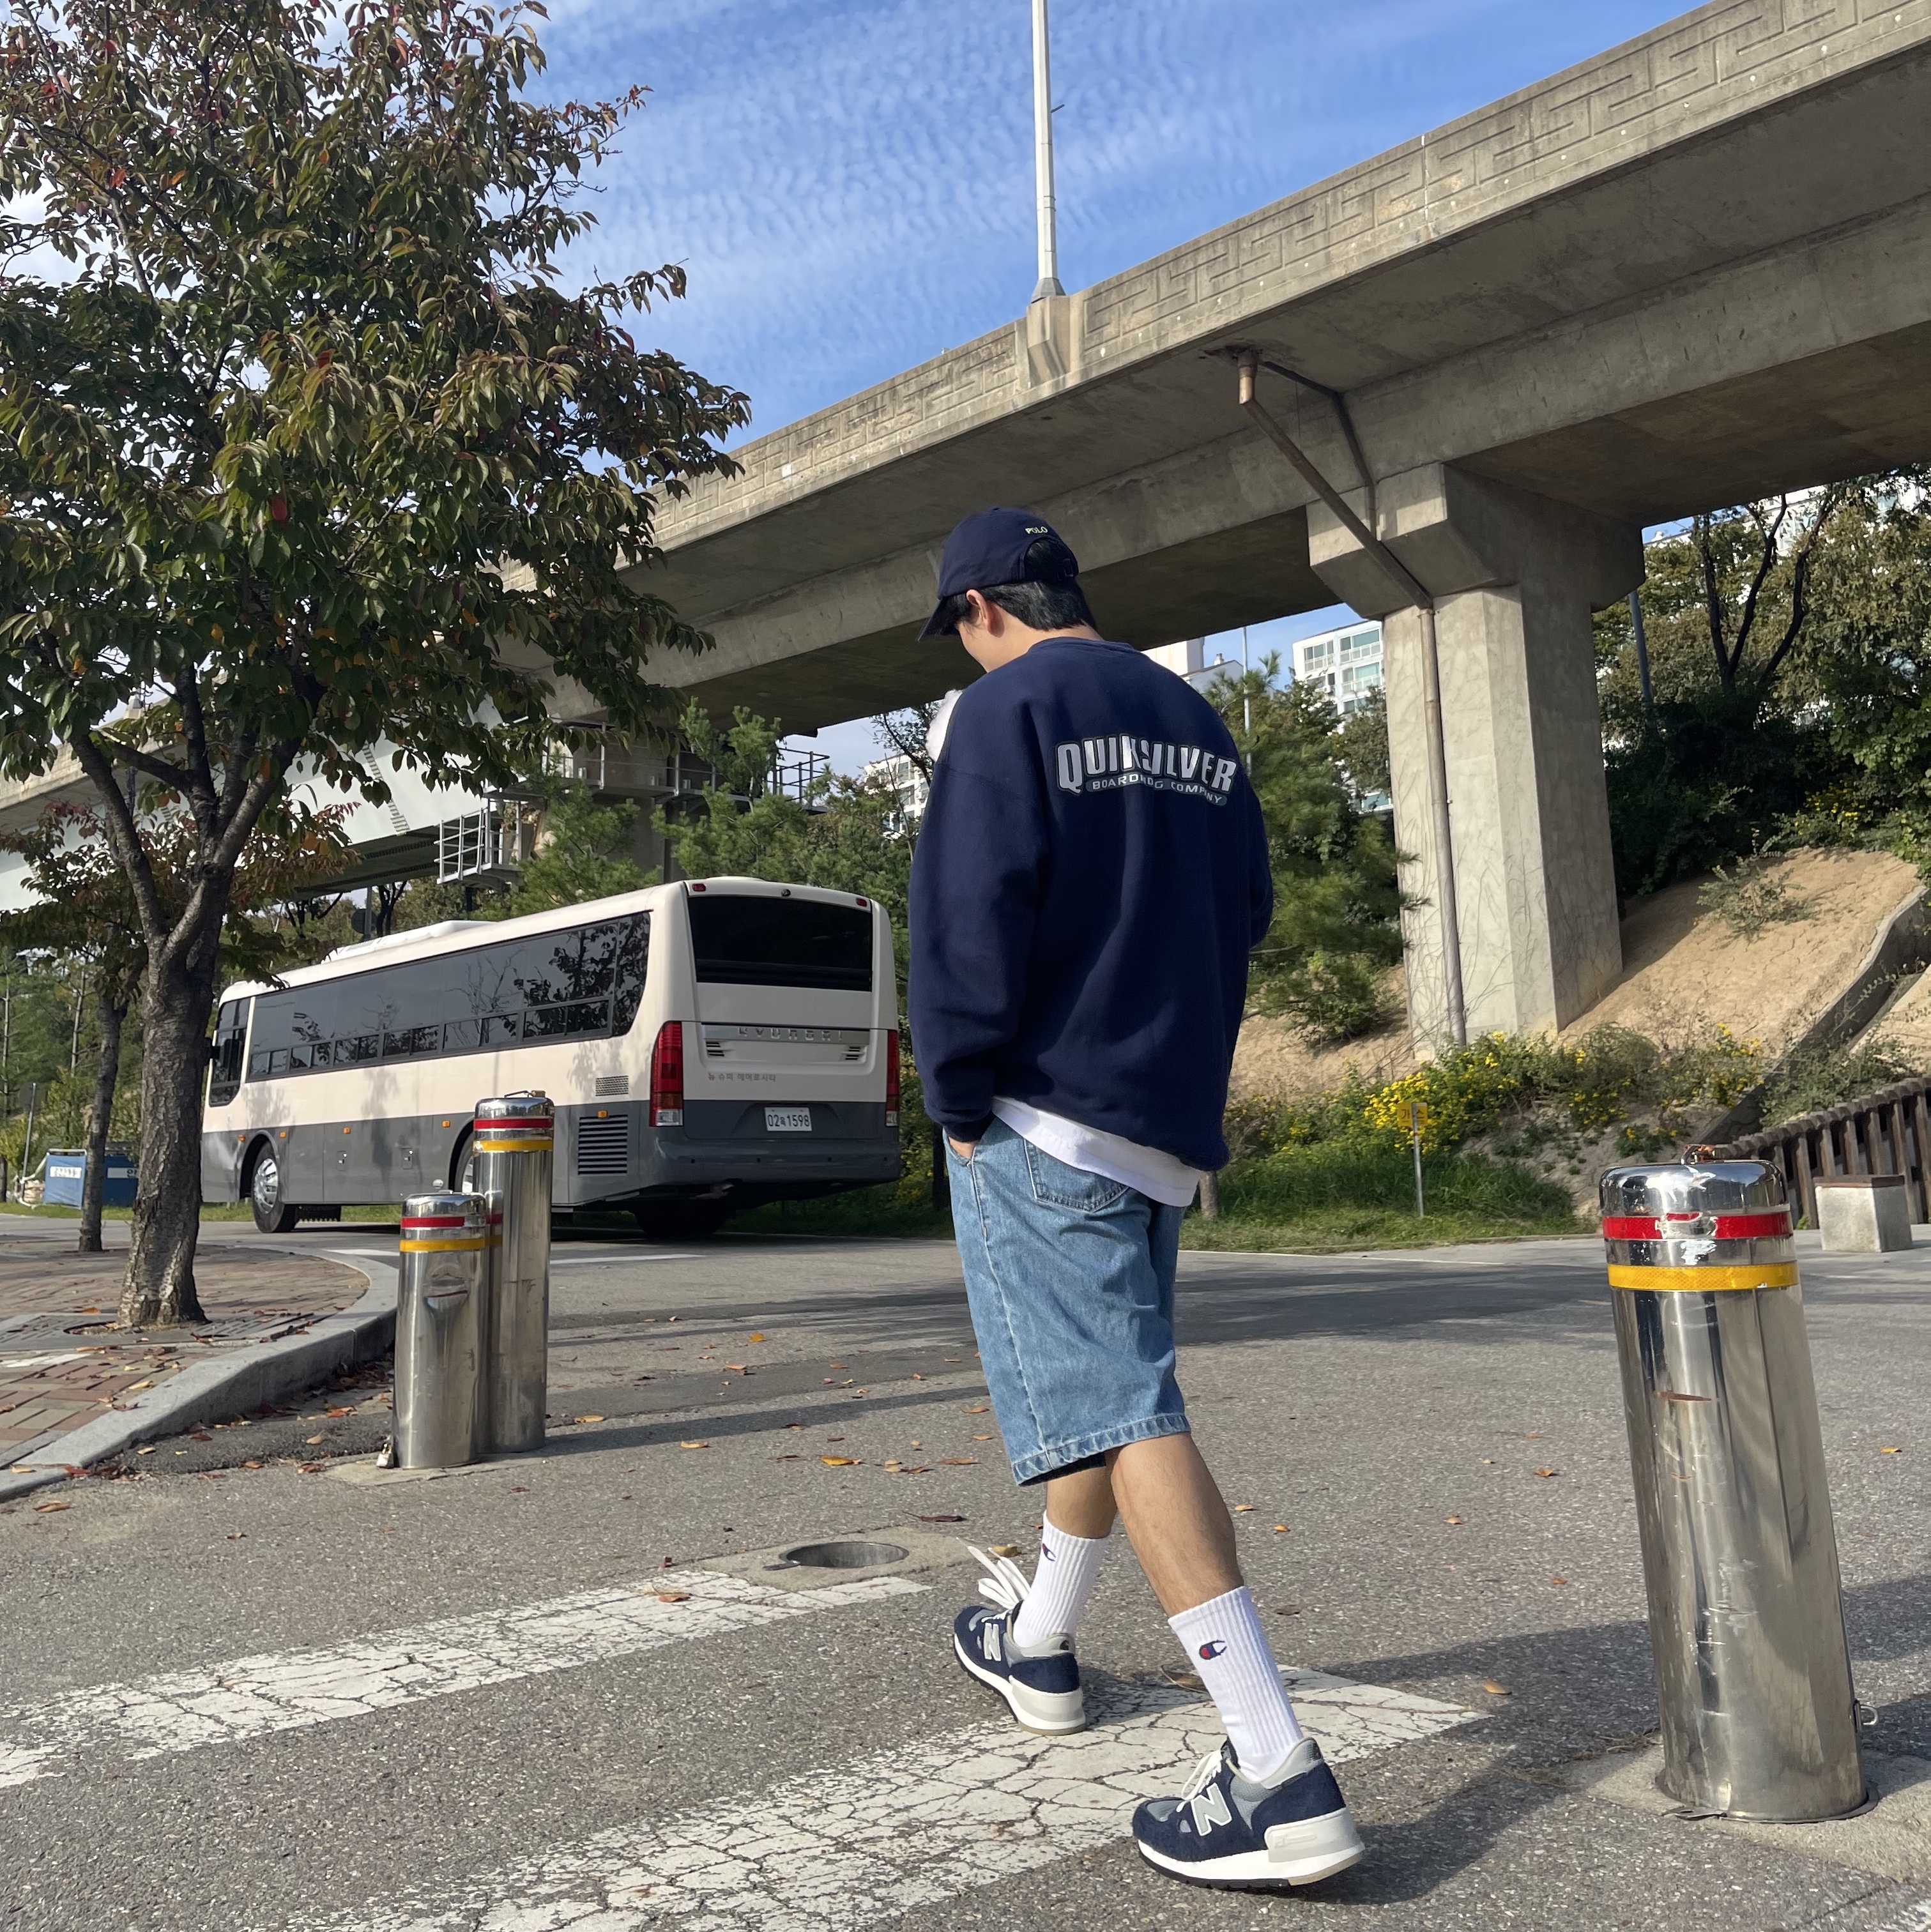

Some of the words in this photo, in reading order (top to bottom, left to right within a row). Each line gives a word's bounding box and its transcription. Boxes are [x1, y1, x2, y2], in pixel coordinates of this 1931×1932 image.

[1025, 526, 1048, 534] POLO
[1057, 734, 1237, 795] QUIKSILVER
[1400, 1109, 1424, 1120] 가스
[984, 1622, 1001, 1661] N
[1190, 1782, 1232, 1836] N
